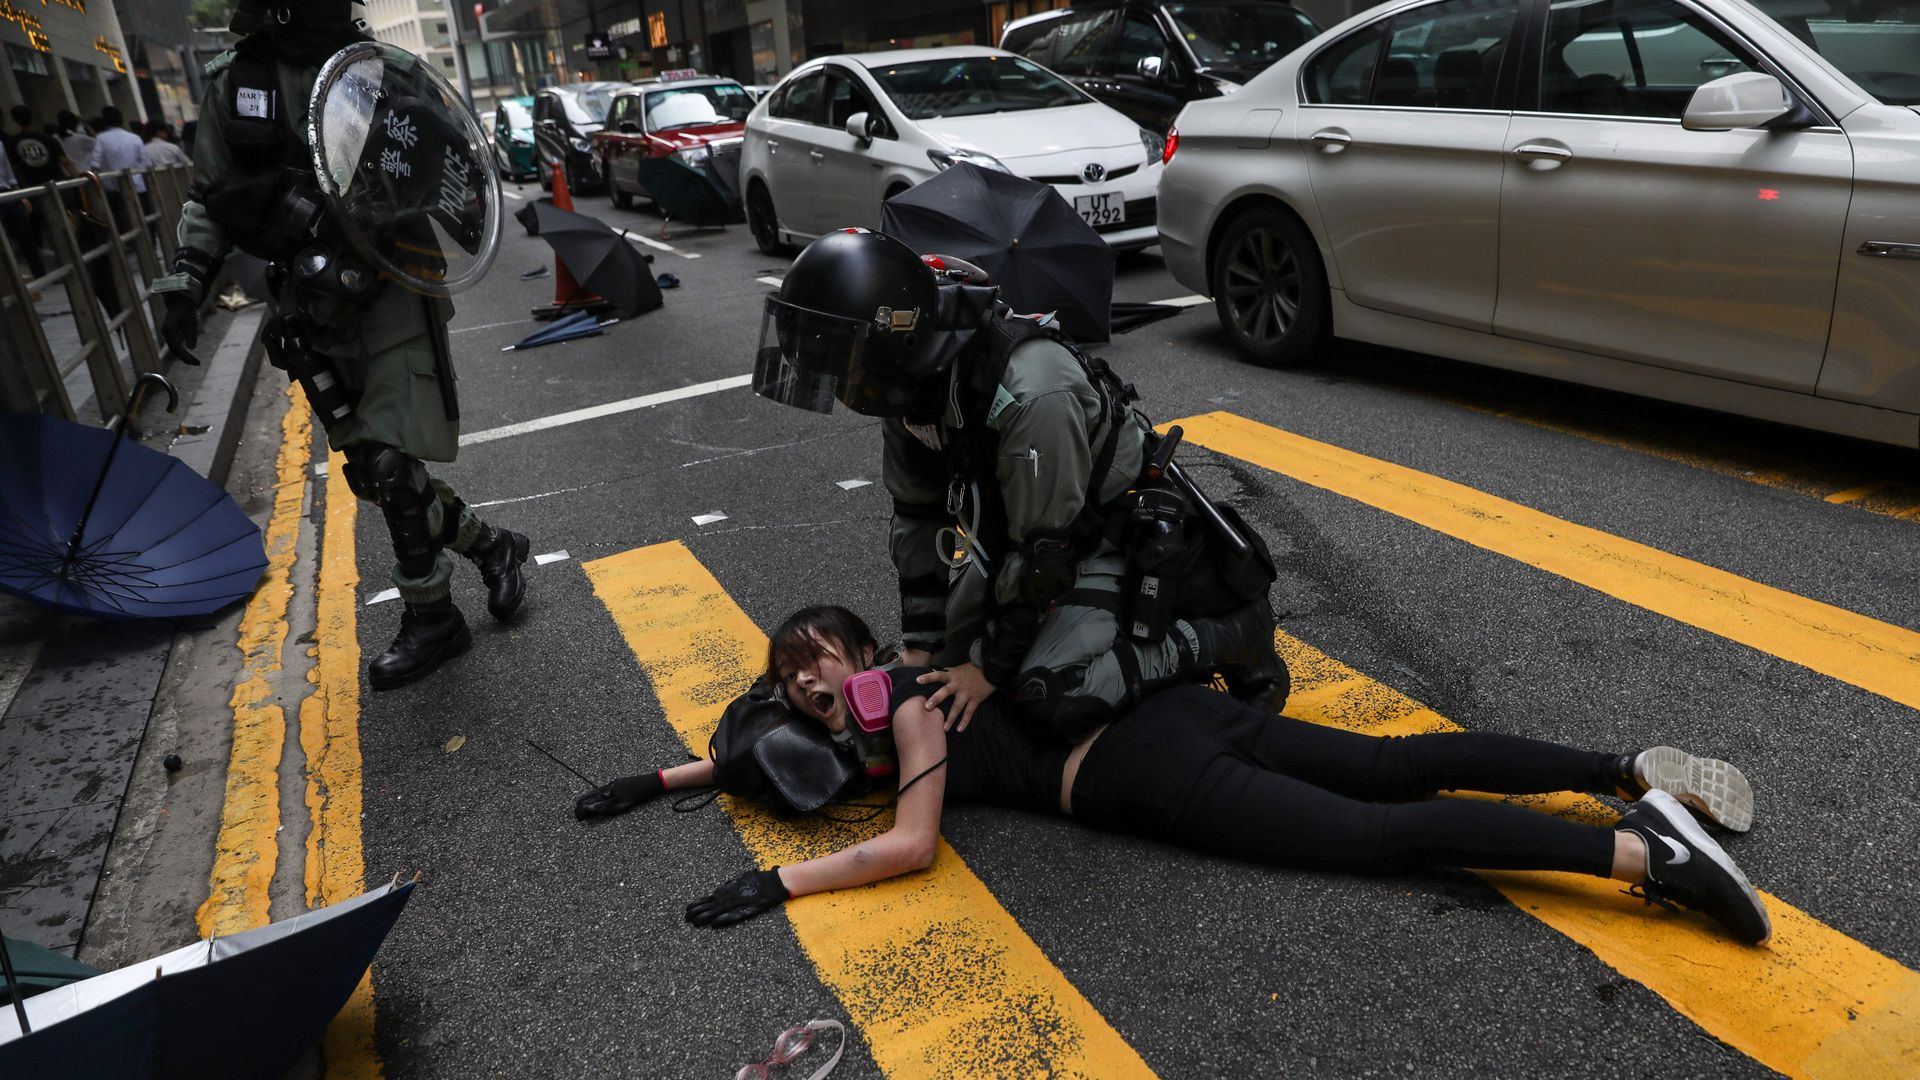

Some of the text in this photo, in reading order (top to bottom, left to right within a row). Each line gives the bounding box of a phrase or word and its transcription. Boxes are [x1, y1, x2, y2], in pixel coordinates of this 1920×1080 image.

[438, 144, 470, 225] POLICE
[1091, 194, 1110, 210] UT
[1081, 207, 1121, 225] 7292
